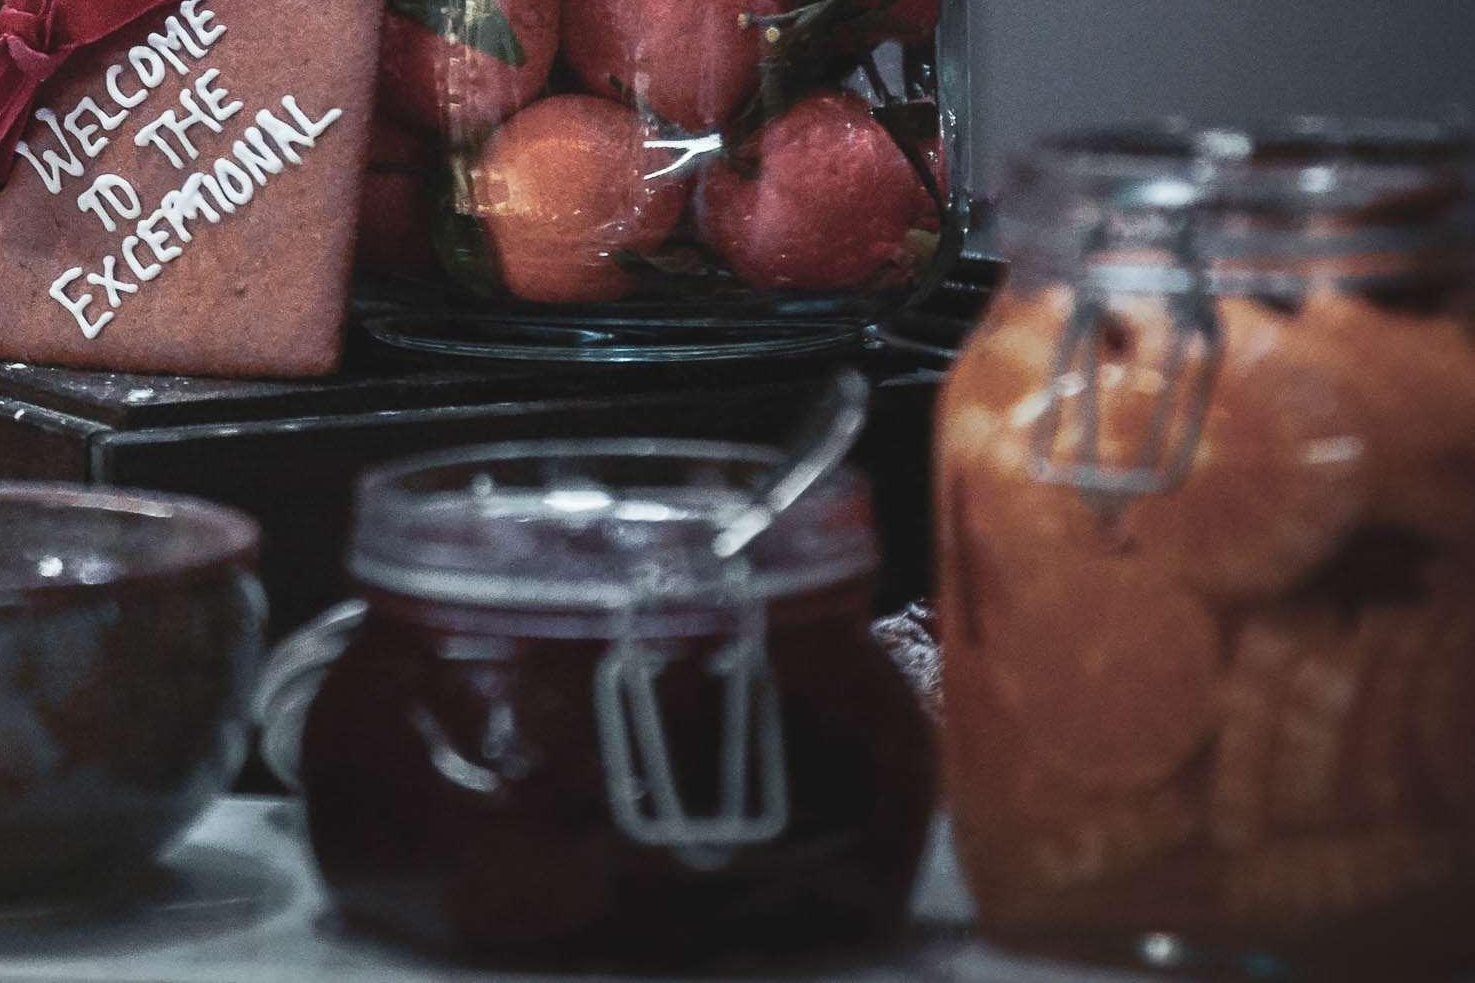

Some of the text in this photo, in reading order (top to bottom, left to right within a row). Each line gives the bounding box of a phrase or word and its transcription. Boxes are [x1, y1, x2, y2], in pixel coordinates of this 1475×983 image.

[47, 94, 343, 340] EXCEPTIONAL
[76, 67, 245, 233] TO THE
